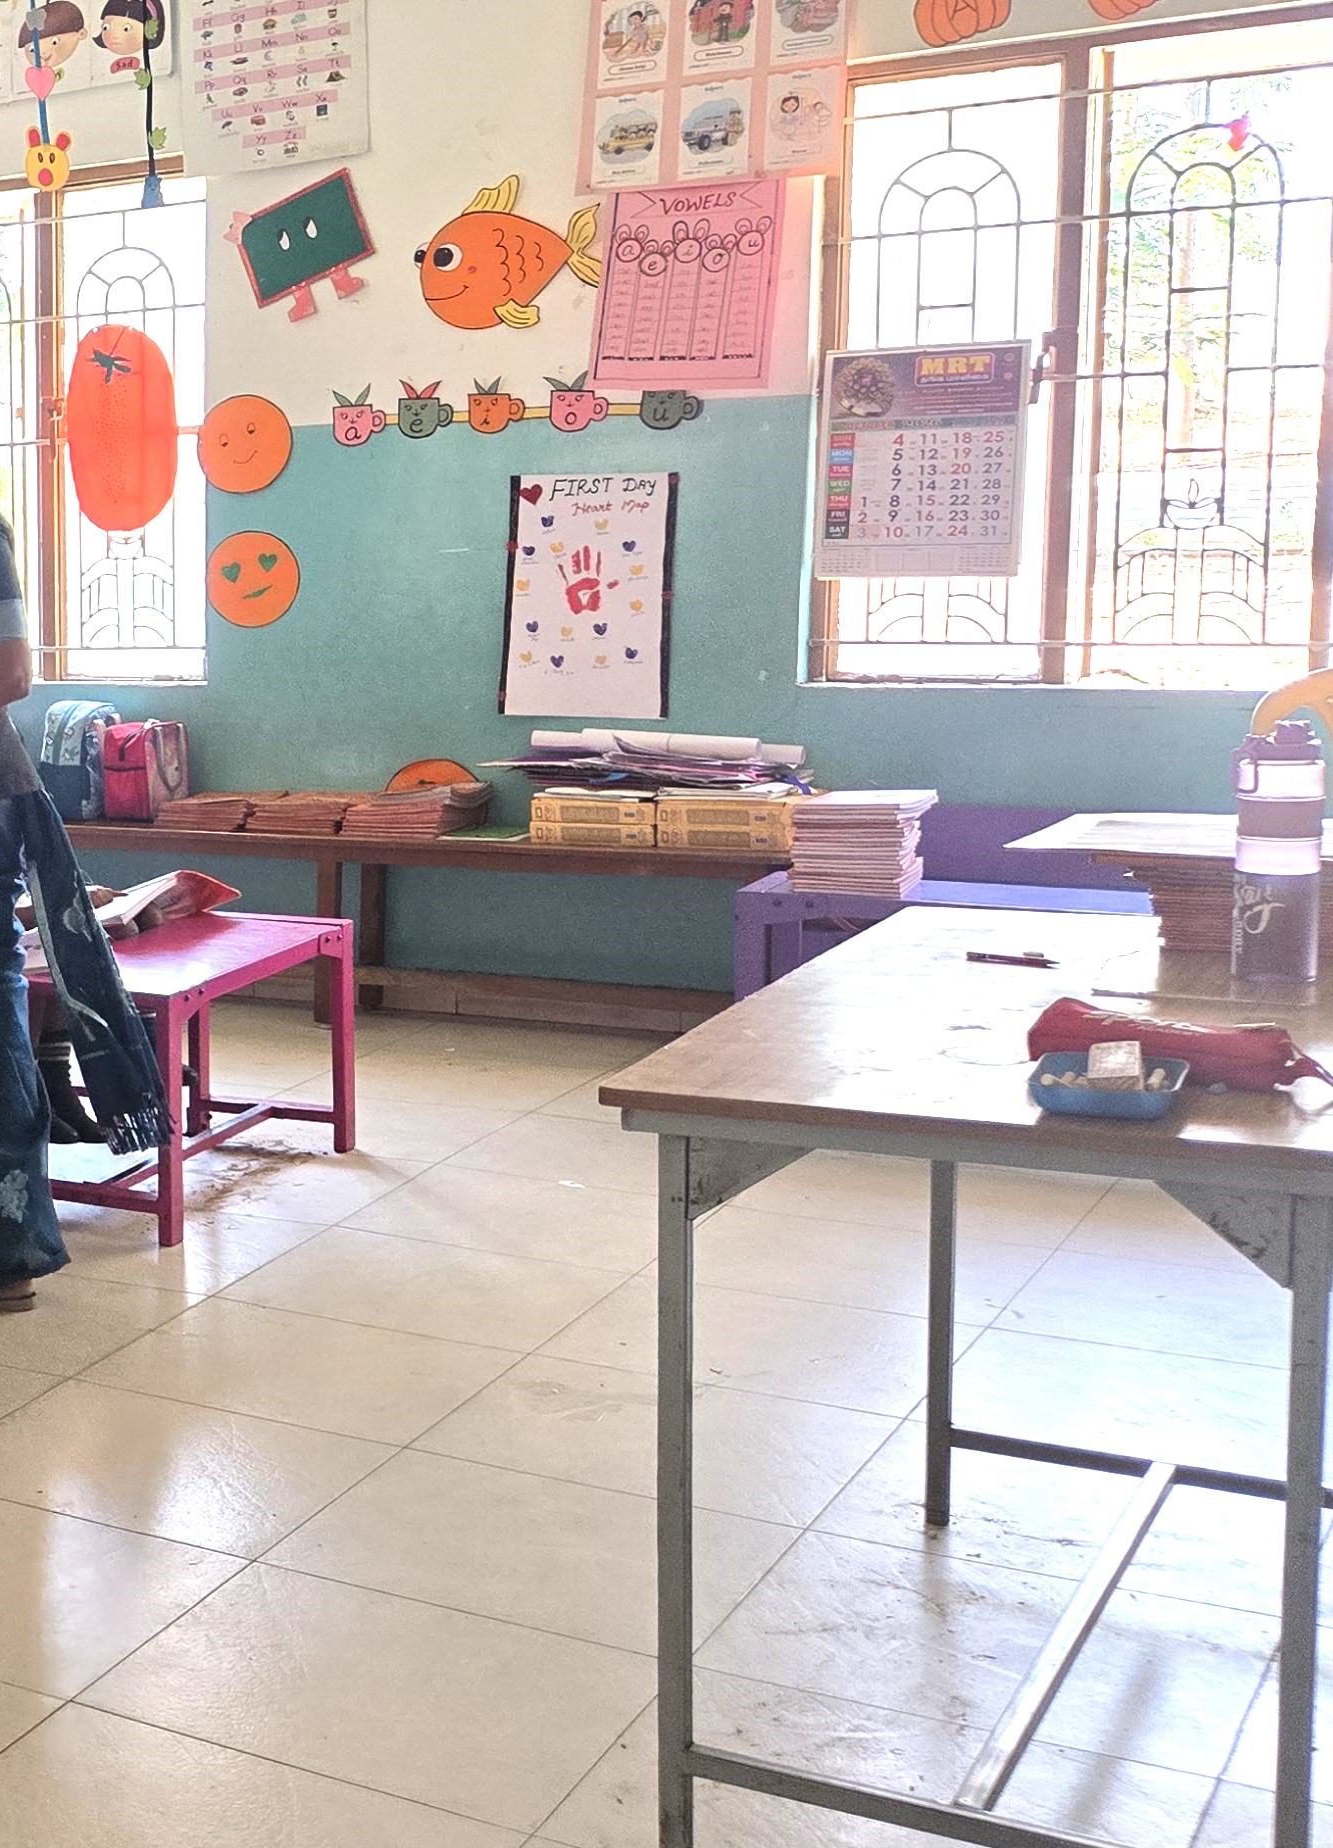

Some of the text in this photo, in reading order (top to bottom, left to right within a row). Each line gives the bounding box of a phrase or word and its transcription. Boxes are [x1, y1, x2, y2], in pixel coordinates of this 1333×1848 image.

[116, 60, 134, 69] Sad
[659, 191, 737, 215] VOWELS
[748, 237, 760, 248] u
[621, 244, 696, 256] a i
[647, 260, 657, 271] e
[920, 355, 991, 376] MRT
[479, 413, 492, 426] i
[564, 412, 577, 425] o
[652, 408, 670, 423] u
[409, 418, 424, 433] e
[344, 425, 362, 441] a
[893, 434, 904, 447] 4
[920, 433, 937, 445] 11
[953, 432, 972, 444] 18
[983, 431, 1004, 443] 25
[892, 448, 903, 461] 5
[919, 449, 938, 460] 12
[953, 447, 972, 459] 19
[984, 446, 1004, 458] 26
[891, 463, 902, 476] 6
[918, 464, 937, 476] 13
[950, 463, 971, 474] 20
[983, 462, 1003, 474] 27
[549, 477, 657, 501] FIRST DAY
[891, 479, 901, 491] 7
[918, 480, 936, 492] 14
[950, 479, 969, 490] 21
[982, 478, 1002, 489] 28
[861, 496, 867, 507] 1
[889, 495, 900, 507] 8
[917, 495, 935, 506] 15
[948, 494, 970, 506] 22
[981, 494, 1001, 506] 29
[571, 499, 650, 517] Heart Map
[858, 512, 868, 524] 2
[888, 510, 898, 522] 9
[916, 510, 934, 522] 16
[948, 510, 969, 522] 23
[980, 510, 1000, 521] 30
[828, 525, 997, 538] SAT 3 10 17 24 31
